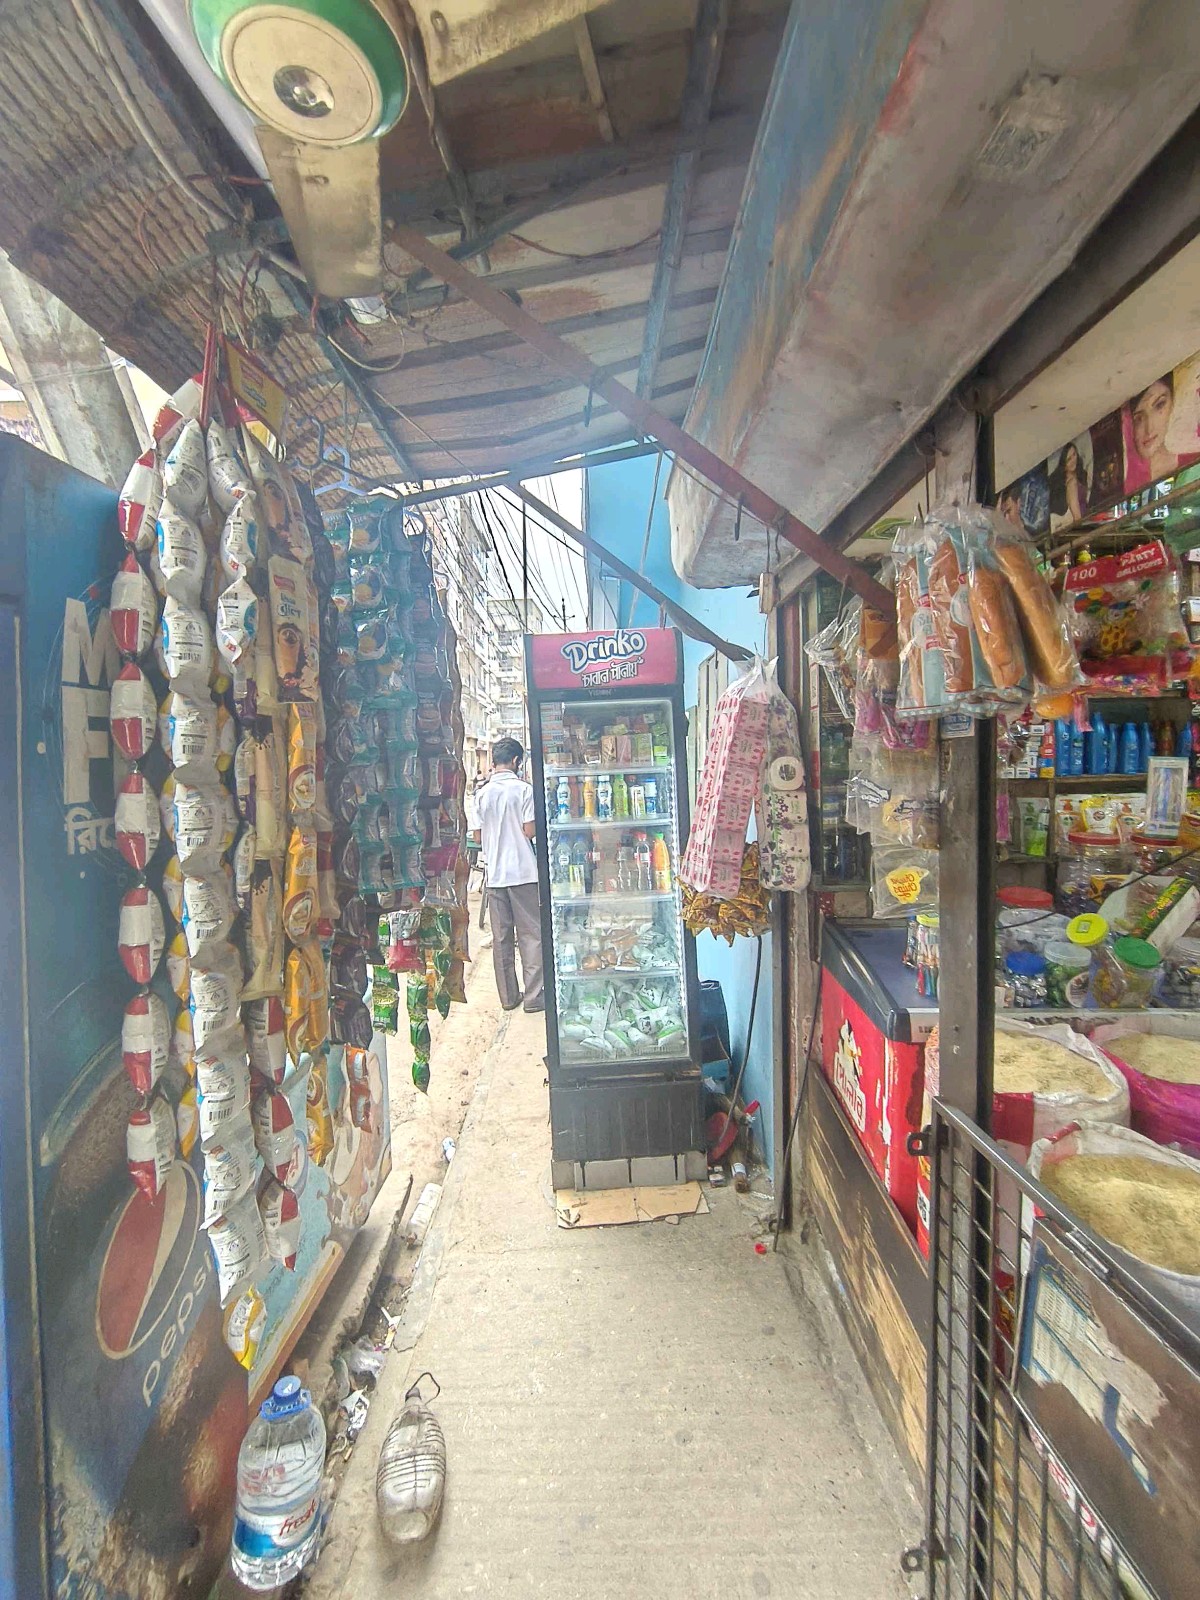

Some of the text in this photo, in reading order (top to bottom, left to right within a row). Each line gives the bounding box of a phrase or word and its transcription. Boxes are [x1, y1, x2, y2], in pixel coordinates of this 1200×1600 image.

[1072, 567, 1097, 581] 100
[561, 629, 646, 673] Drinko
[142, 1249, 213, 1408] pepsi
